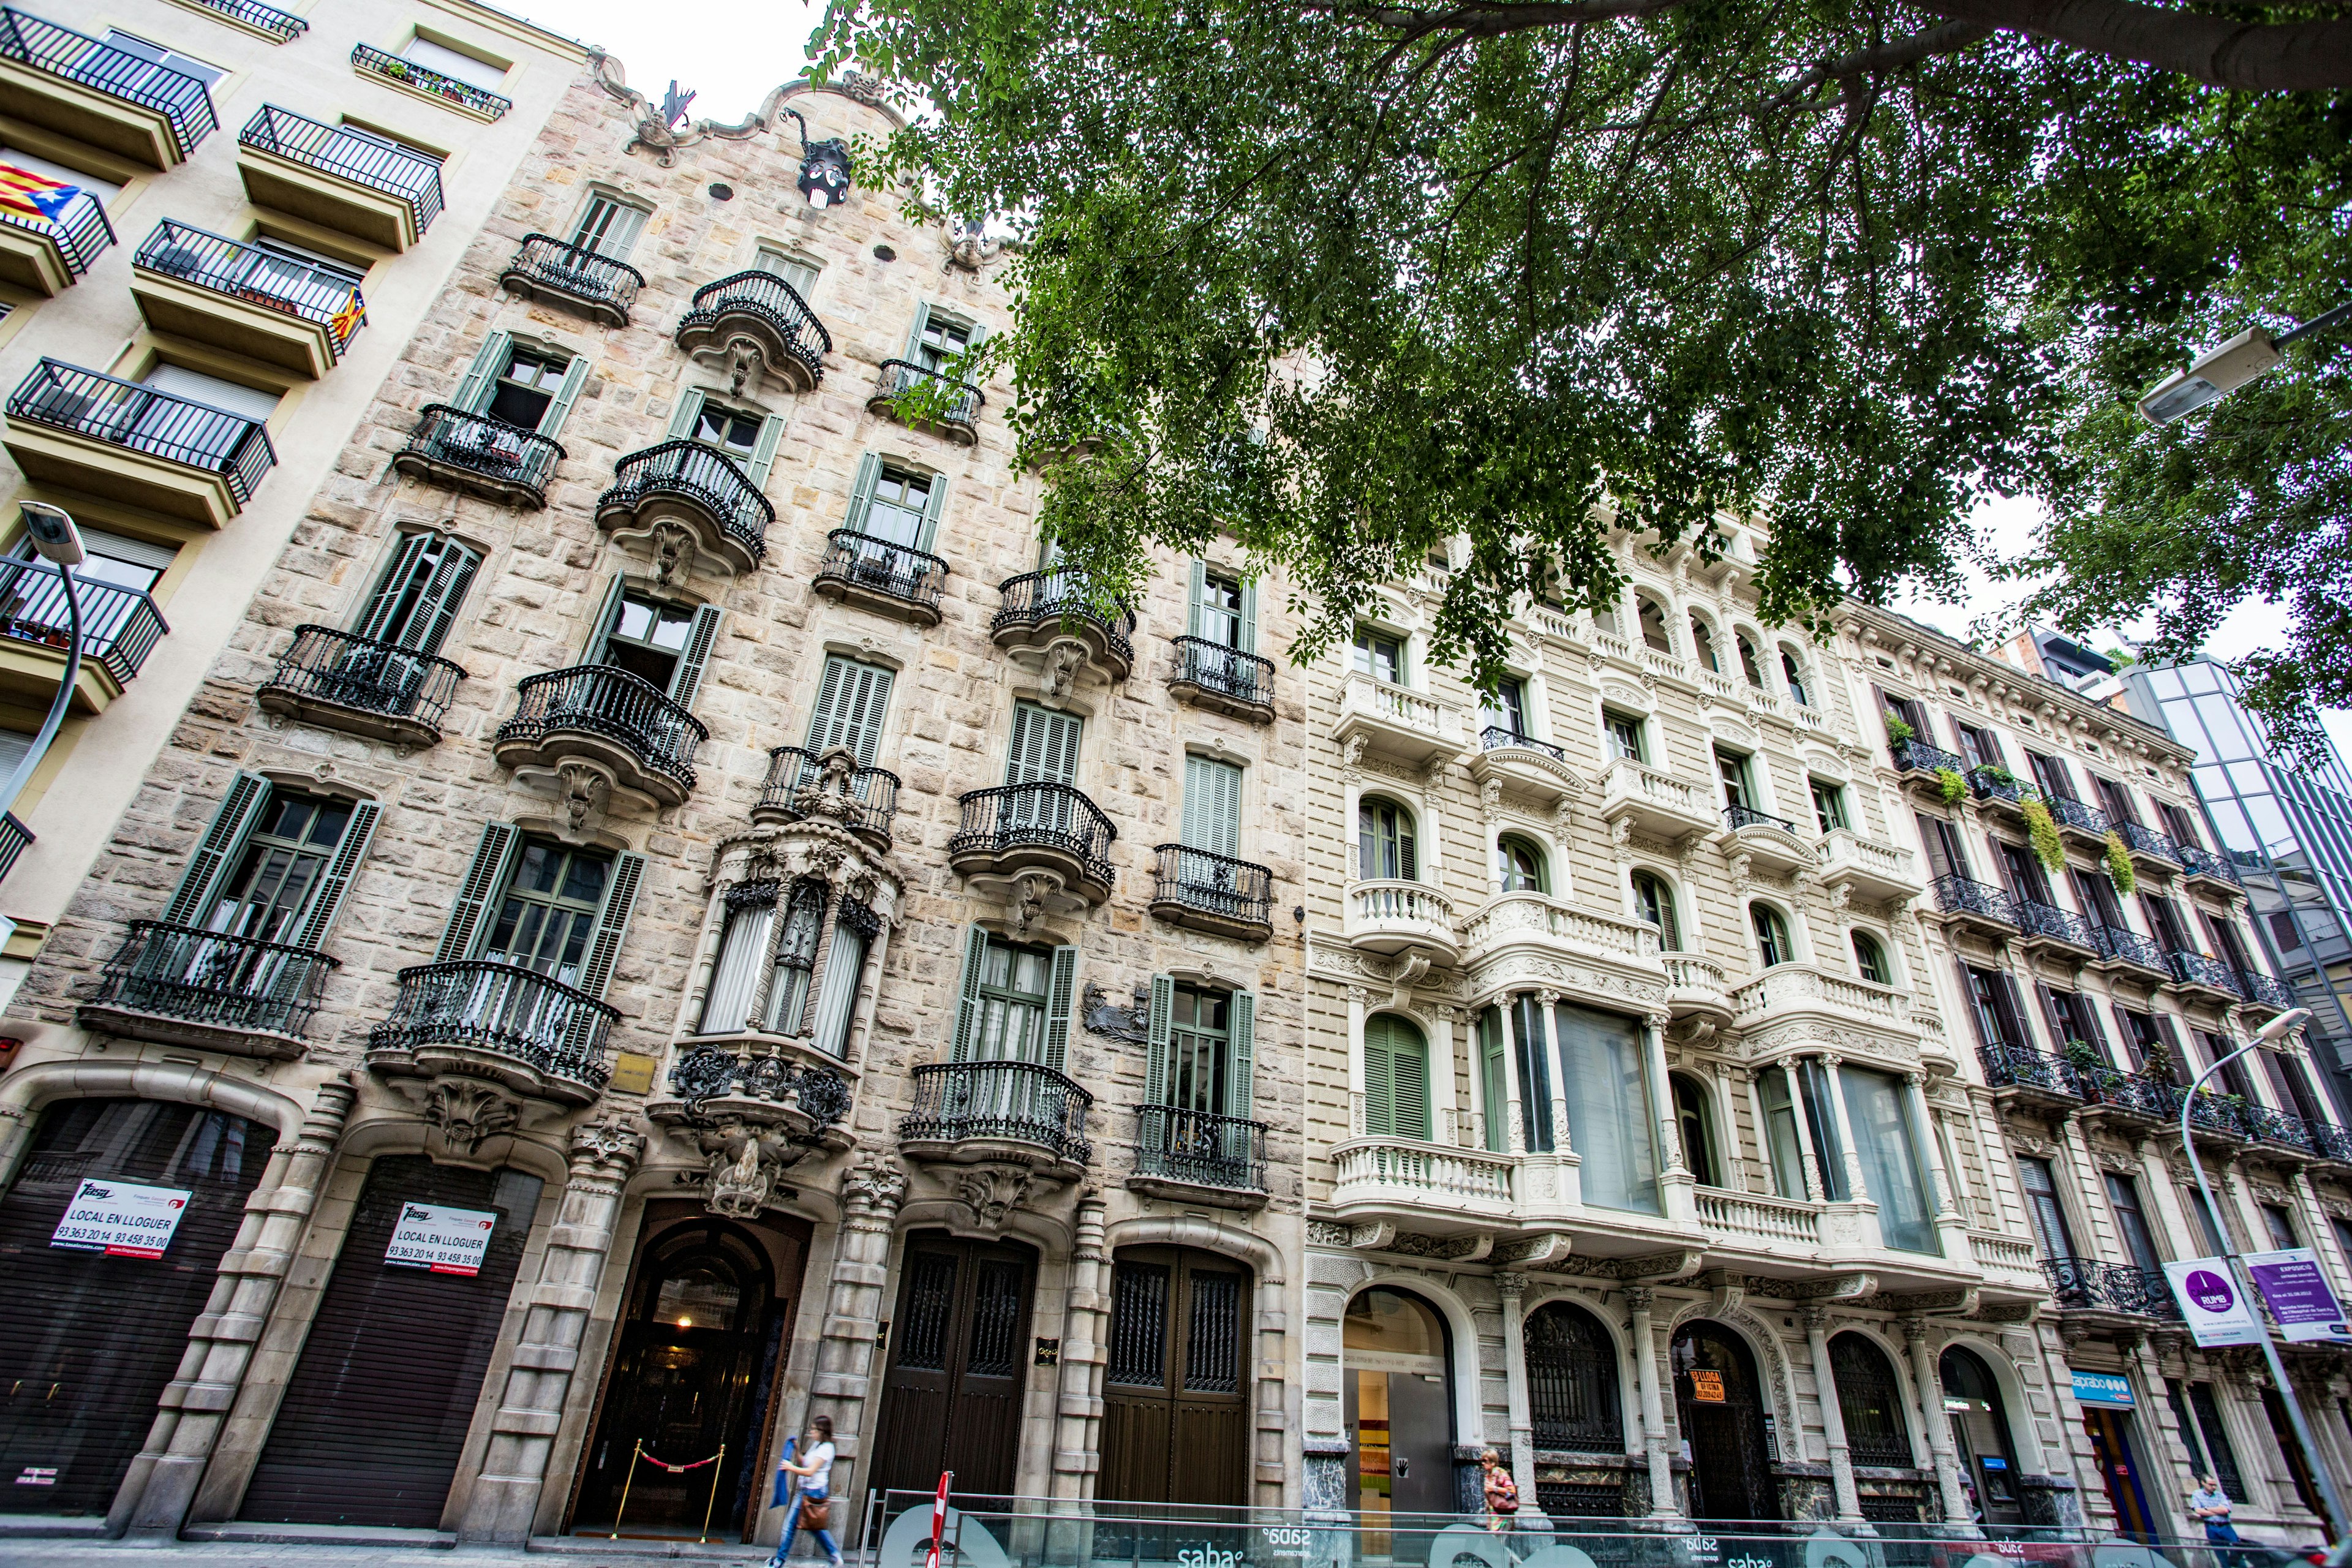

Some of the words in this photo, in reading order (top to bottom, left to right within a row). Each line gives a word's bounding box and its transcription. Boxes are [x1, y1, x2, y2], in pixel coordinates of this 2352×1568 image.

[70, 1210, 104, 1223] LOCAL
[107, 1213, 123, 1224] EN
[123, 1215, 172, 1230] LLOGUER
[57, 1226, 70, 1236] 93
[69, 1227, 88, 1238] 363
[86, 1229, 101, 1240] 20
[101, 1231, 112, 1242] 14
[115, 1232, 127, 1243] 93
[127, 1234, 144, 1245] 458
[143, 1235, 156, 1246] 35
[156, 1237, 168, 1248] 00
[398, 1230, 427, 1243] LOCAL
[429, 1234, 442, 1244] EN
[442, 1235, 483, 1250] LLOGUER
[389, 1246, 399, 1256] 93
[399, 1247, 413, 1257] 363
[414, 1249, 425, 1259] 20
[426, 1251, 434, 1259] 14
[437, 1251, 447, 1261] 93
[448, 1253, 462, 1263] 458
[462, 1254, 472, 1264] 35
[472, 1256, 482, 1265] 00
[2279, 1264, 2312, 1272] EXPOSICIÓ
[2190, 1288, 2215, 1297] CANVI
[2216, 1286, 2230, 1295] DE
[2201, 1295, 2227, 1305] RUMB
[1698, 1371, 1721, 1382] LLOGA
[2071, 1376, 2106, 1390] aprabo
